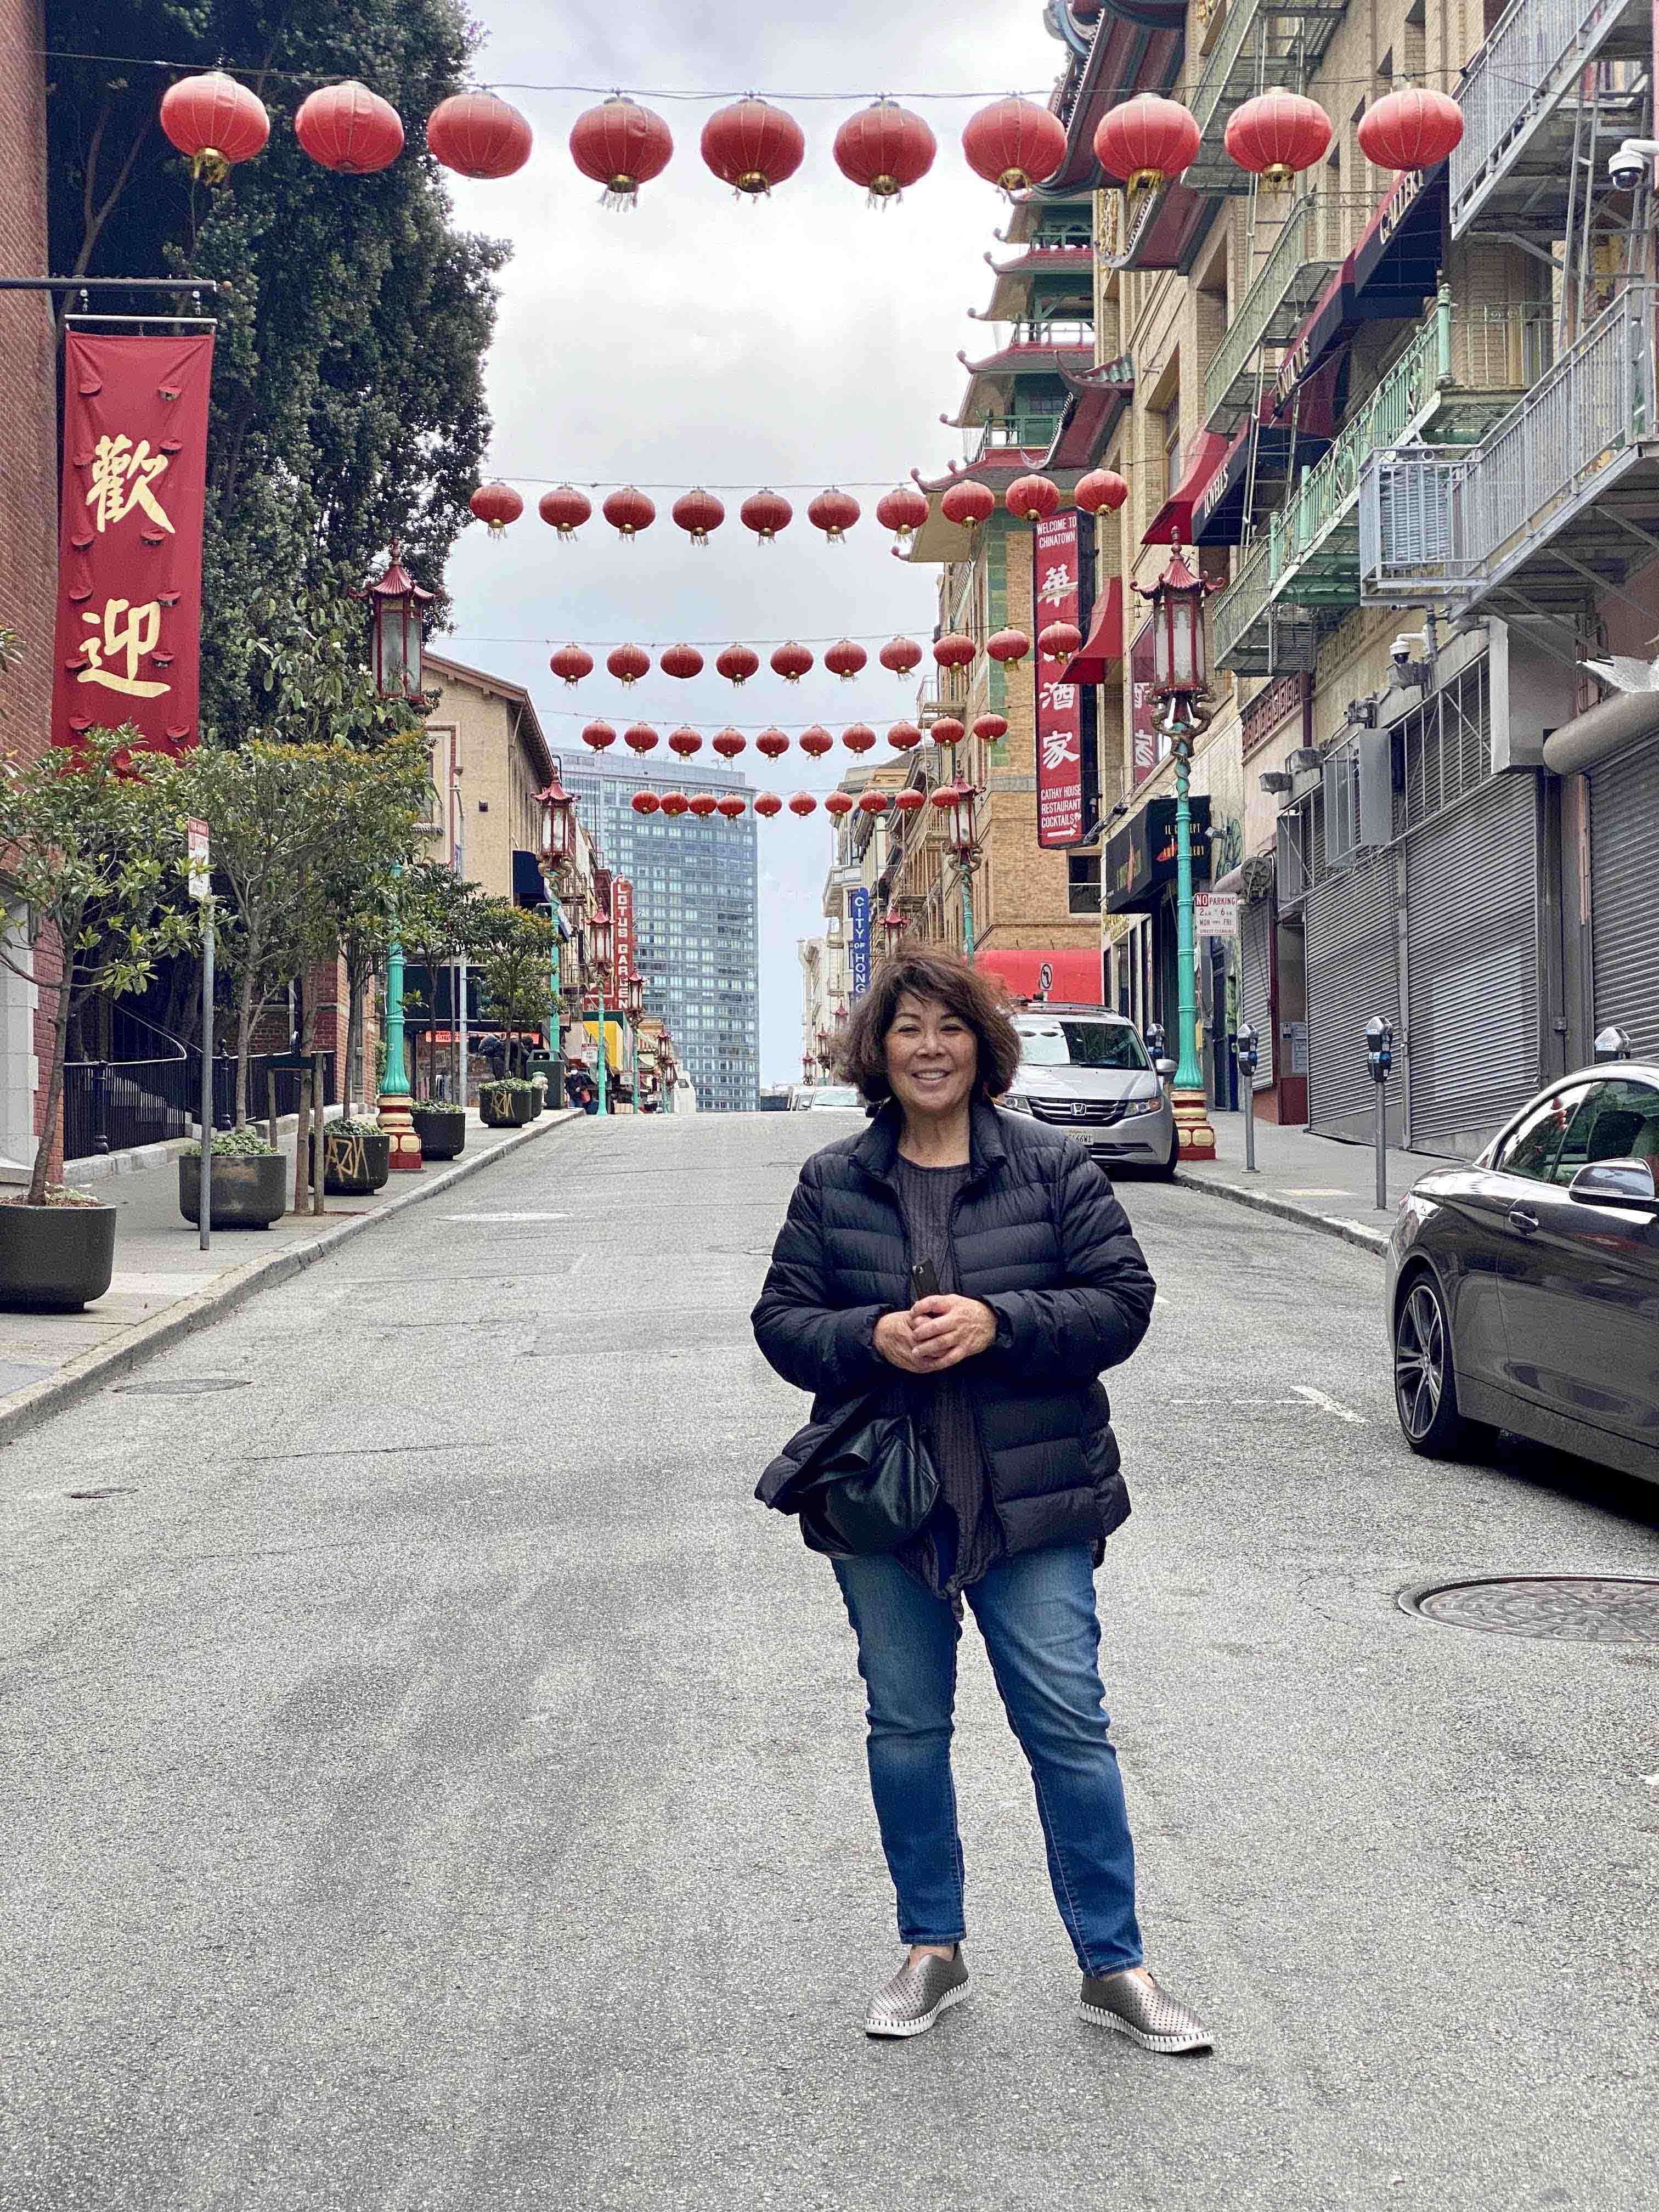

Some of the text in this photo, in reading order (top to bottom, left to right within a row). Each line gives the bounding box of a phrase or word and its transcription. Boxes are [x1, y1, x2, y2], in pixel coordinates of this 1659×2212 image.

[1036, 516, 1077, 535] WELCOME TO
[1039, 530, 1075, 549] CHINATOWN
[78, 433, 176, 698] 歡迎
[1041, 784, 1081, 800] CATHAY HOUSE
[1041, 798, 1081, 815] RESTAURANT
[1041, 814, 1074, 828] COCKTAILS
[1197, 894, 1235, 905] NO PARKING
[617, 883, 628, 938] LOTUS
[854, 896, 865, 939] CITY
[855, 953, 866, 993] HONG
